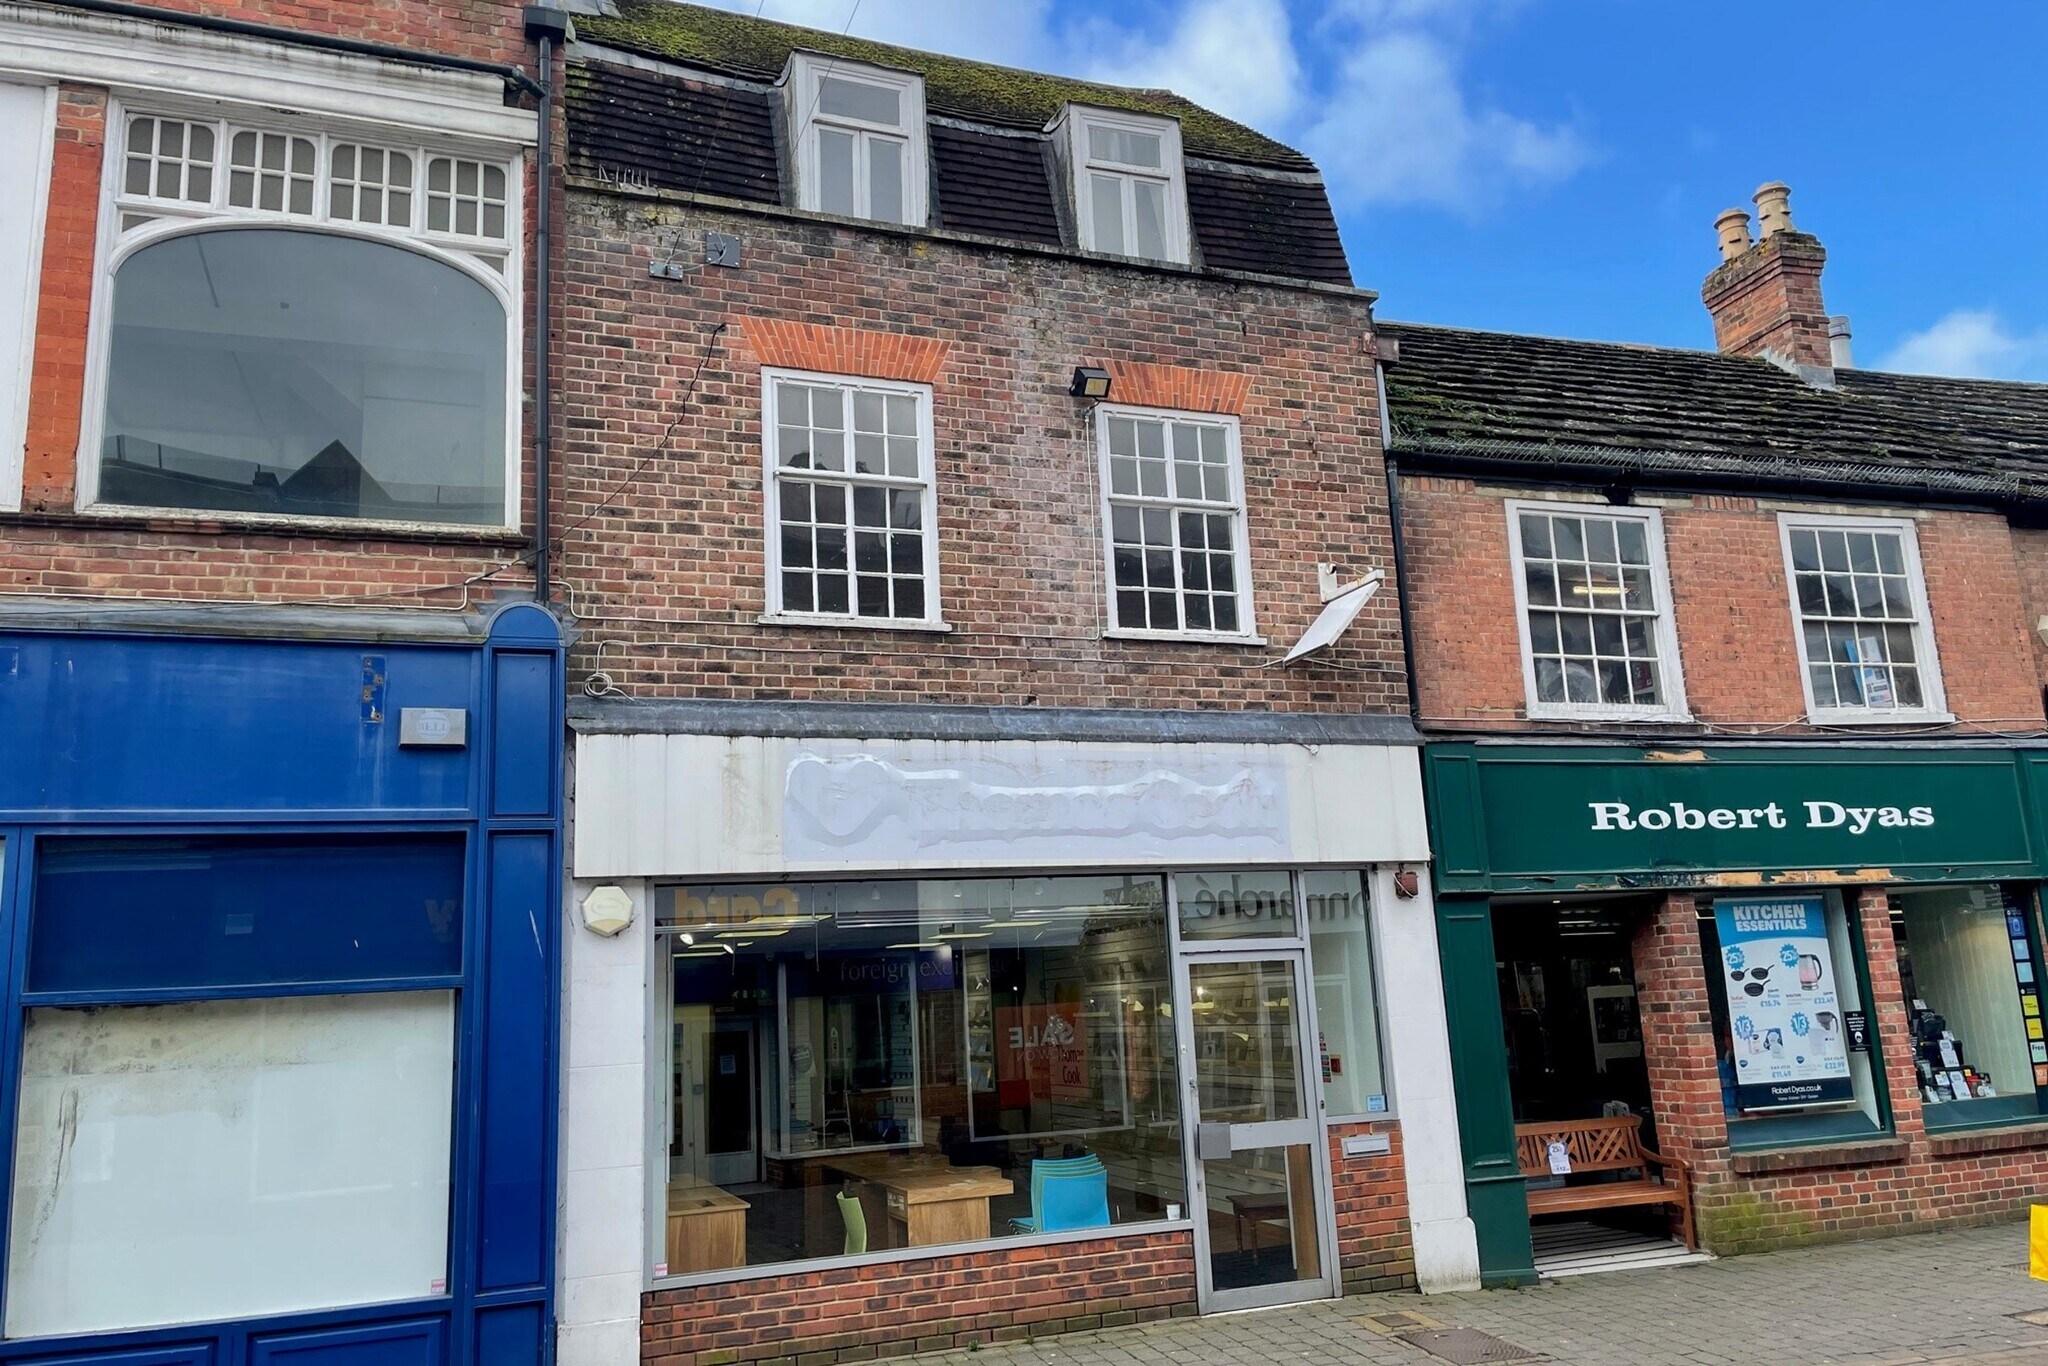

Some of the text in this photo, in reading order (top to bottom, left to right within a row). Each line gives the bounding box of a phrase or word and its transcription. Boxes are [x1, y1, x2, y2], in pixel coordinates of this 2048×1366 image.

[1588, 801, 1935, 834] Robert Dyas
[1732, 903, 1806, 921] KITCHEN
[1735, 918, 1807, 932] ESSENTIALS
[841, 960, 911, 983] foreign
[1062, 1065, 1082, 1085] Cook
